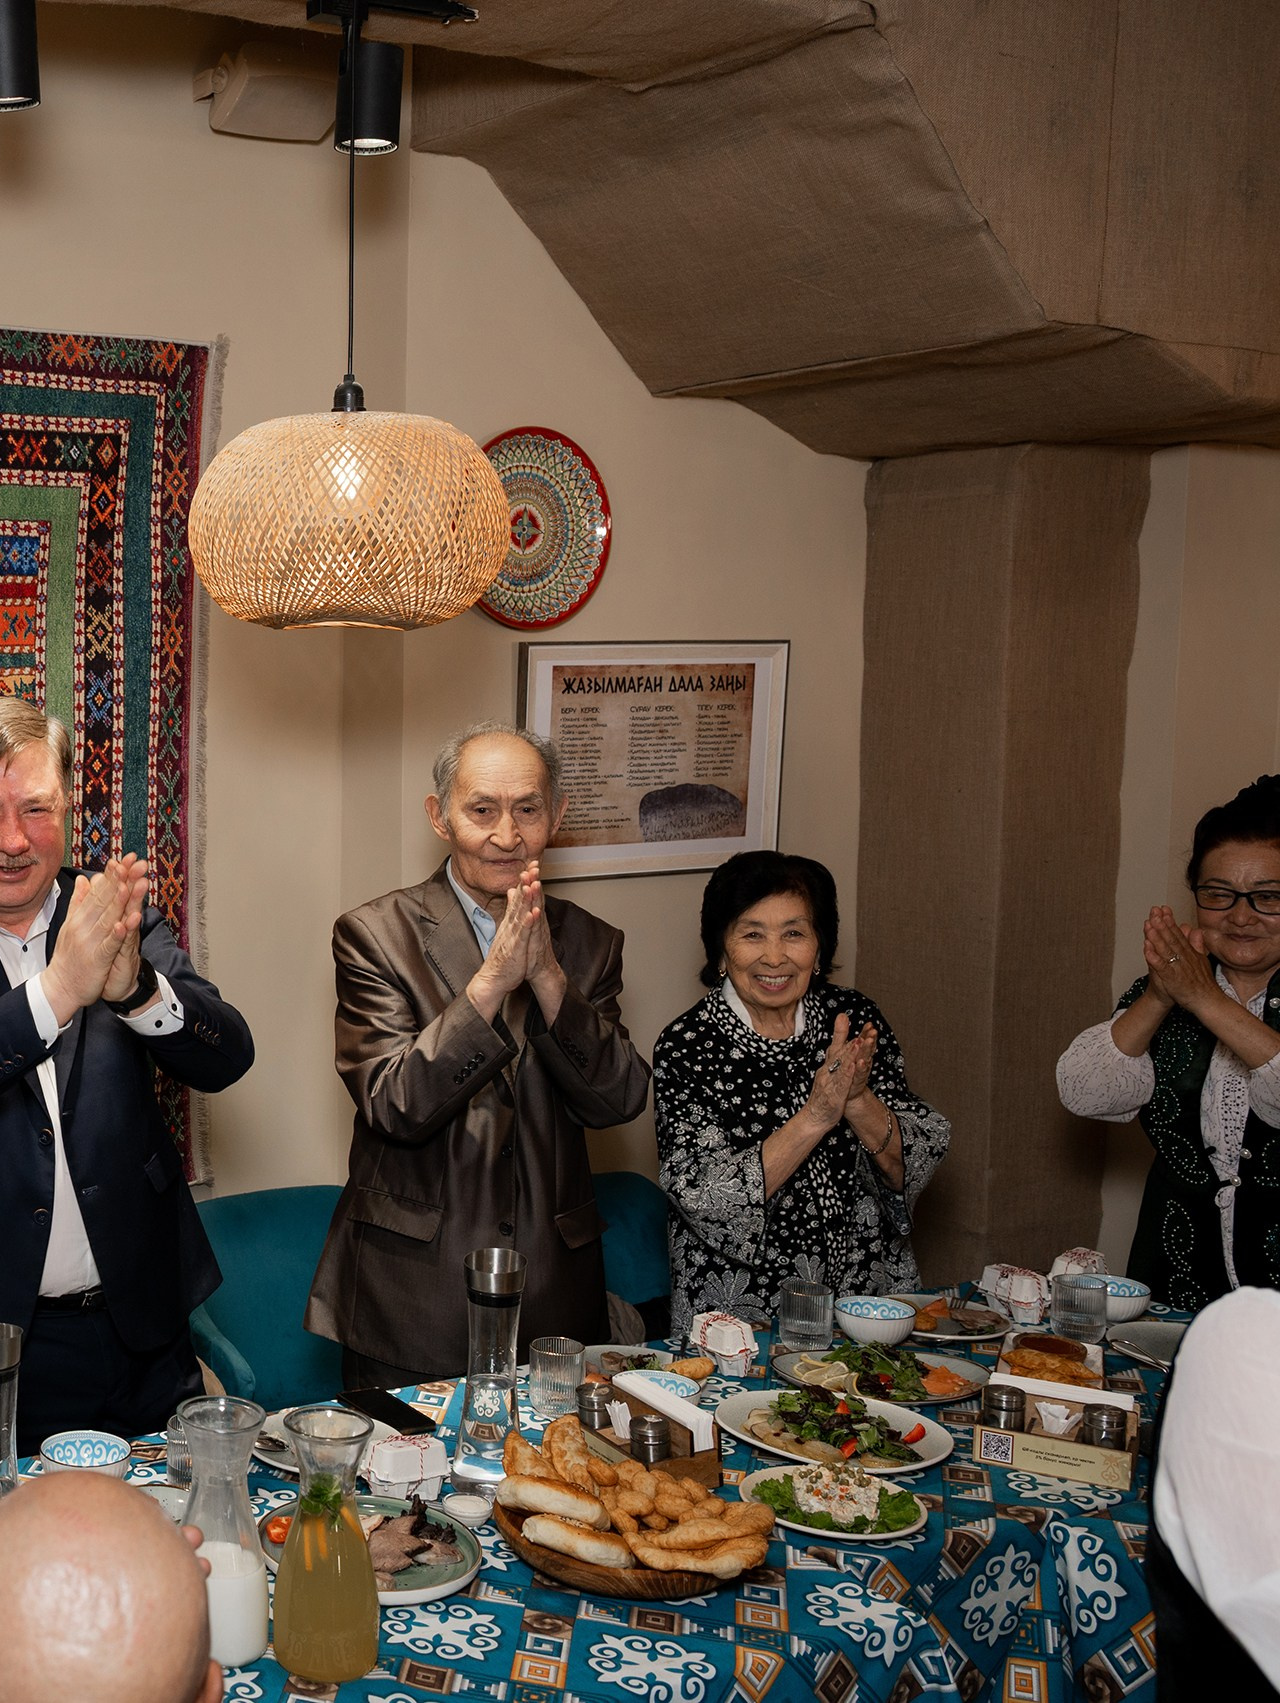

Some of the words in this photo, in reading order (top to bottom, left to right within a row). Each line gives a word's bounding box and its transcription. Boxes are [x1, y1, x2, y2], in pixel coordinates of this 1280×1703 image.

[562, 676, 663, 694] ЖАЗЫЛМАҒАН
[668, 676, 704, 693] ДАЛА
[710, 675, 747, 695] ЗАҢЫ
